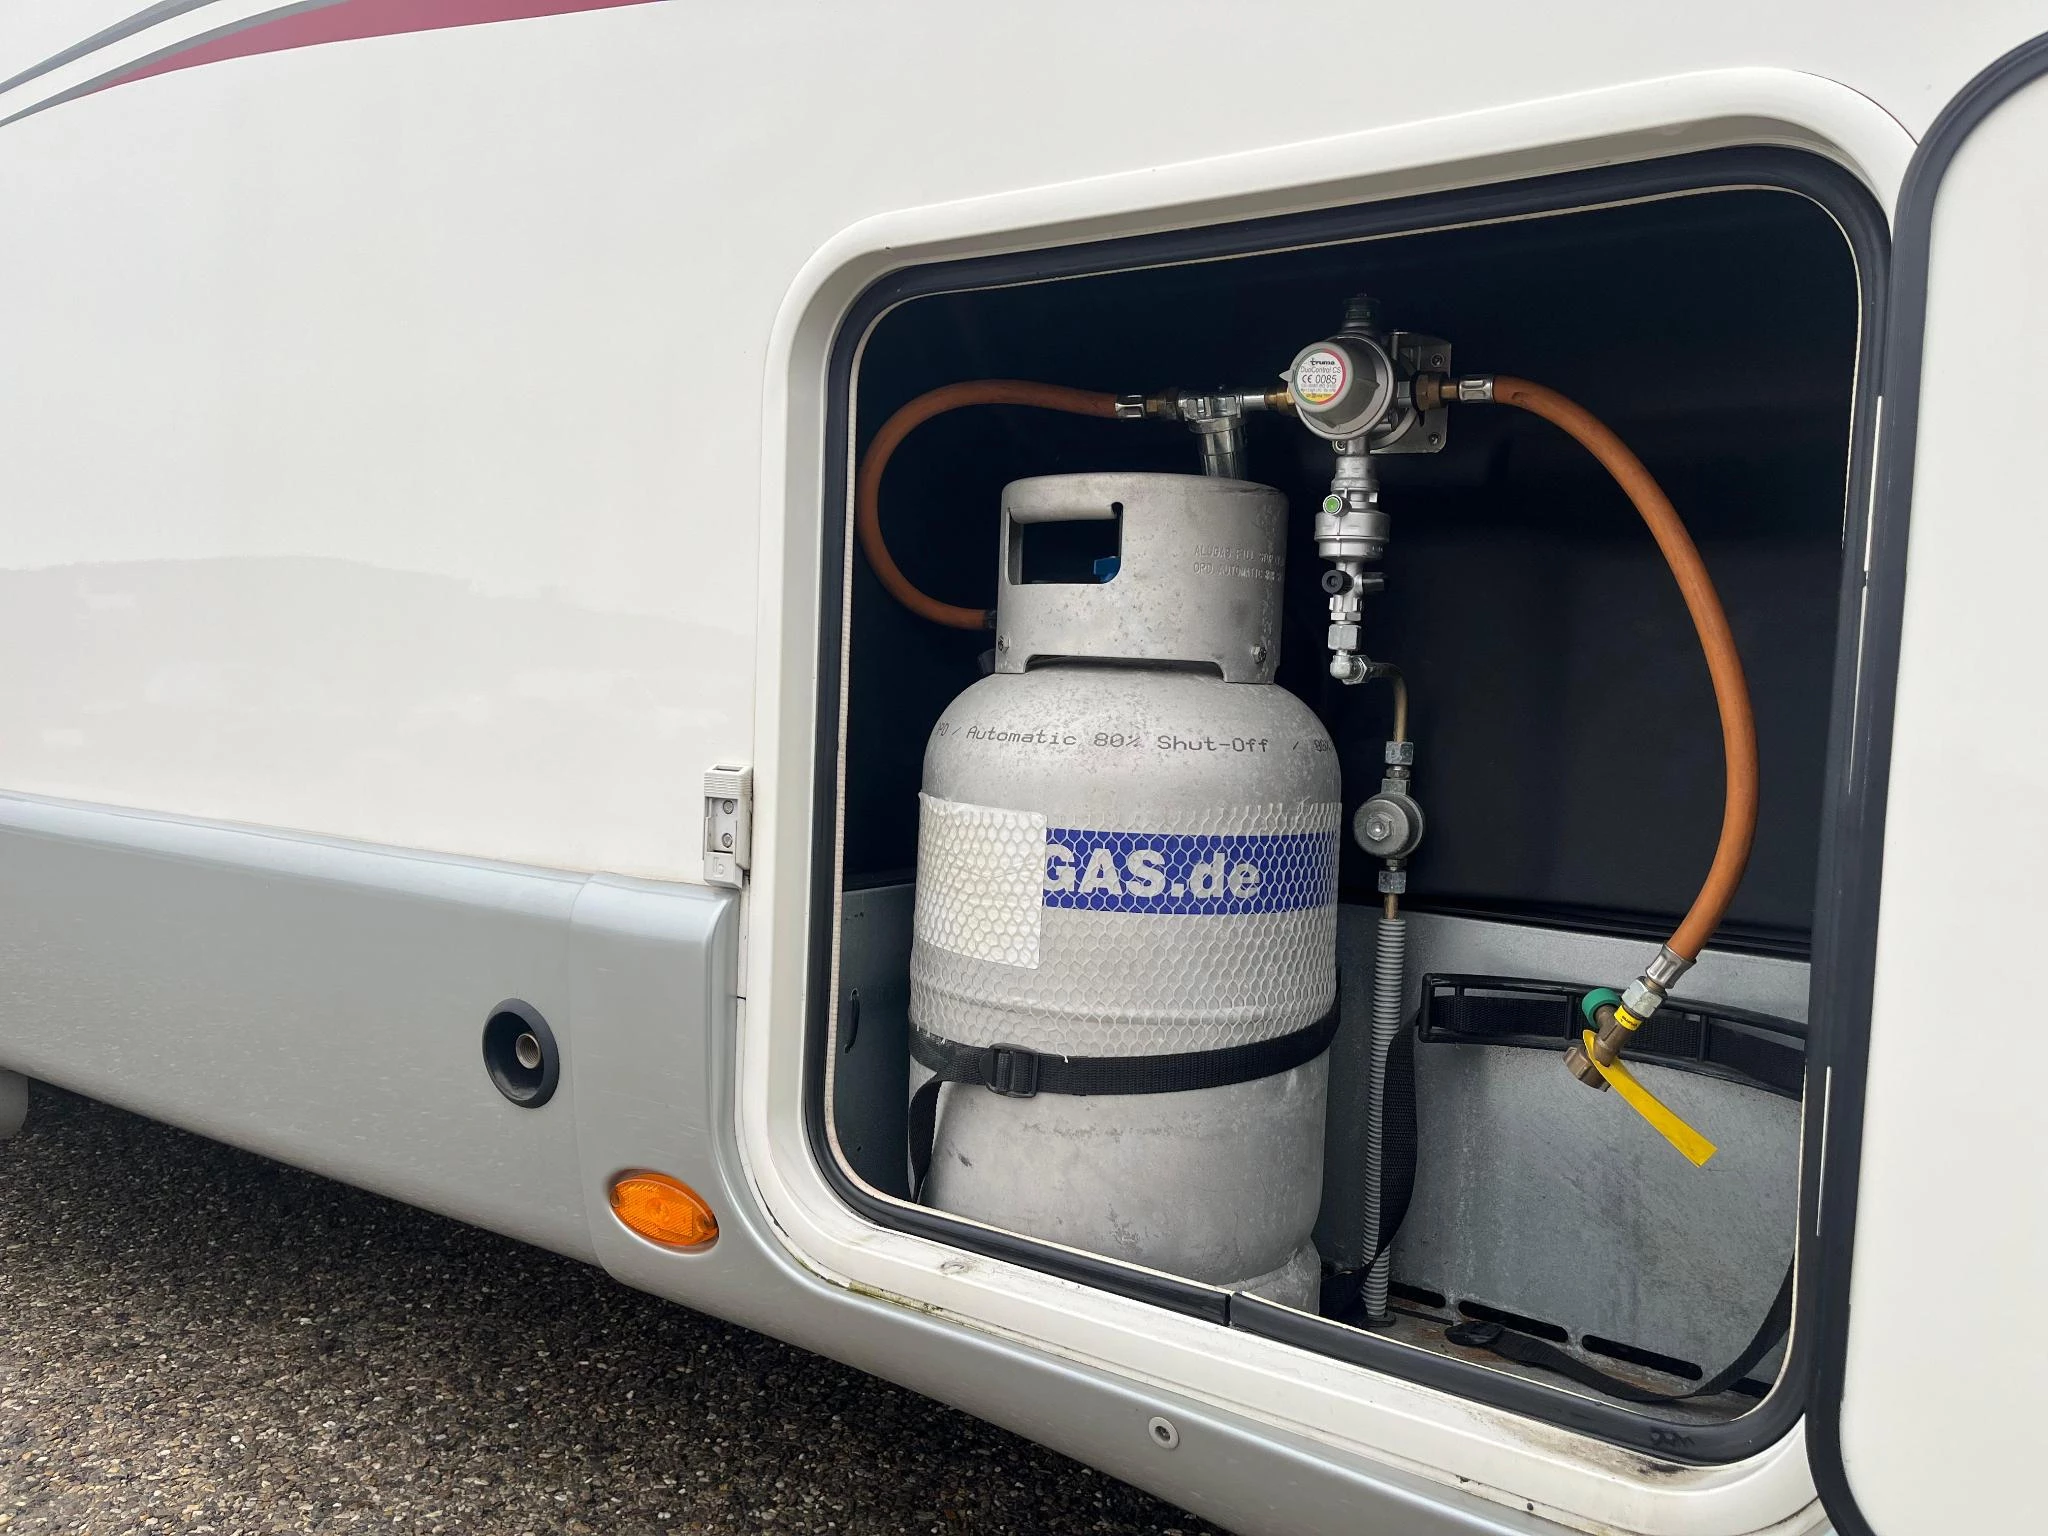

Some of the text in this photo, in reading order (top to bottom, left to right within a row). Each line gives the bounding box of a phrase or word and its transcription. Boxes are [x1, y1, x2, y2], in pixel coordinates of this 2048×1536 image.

[1315, 374, 1337, 384] 0085
[1193, 562, 1214, 575] OPD
[966, 725, 1077, 745] Automatic
[1093, 732, 1141, 748] 80%
[1157, 735, 1269, 753] Shut-Off
[1044, 843, 1261, 899] GAS.de
